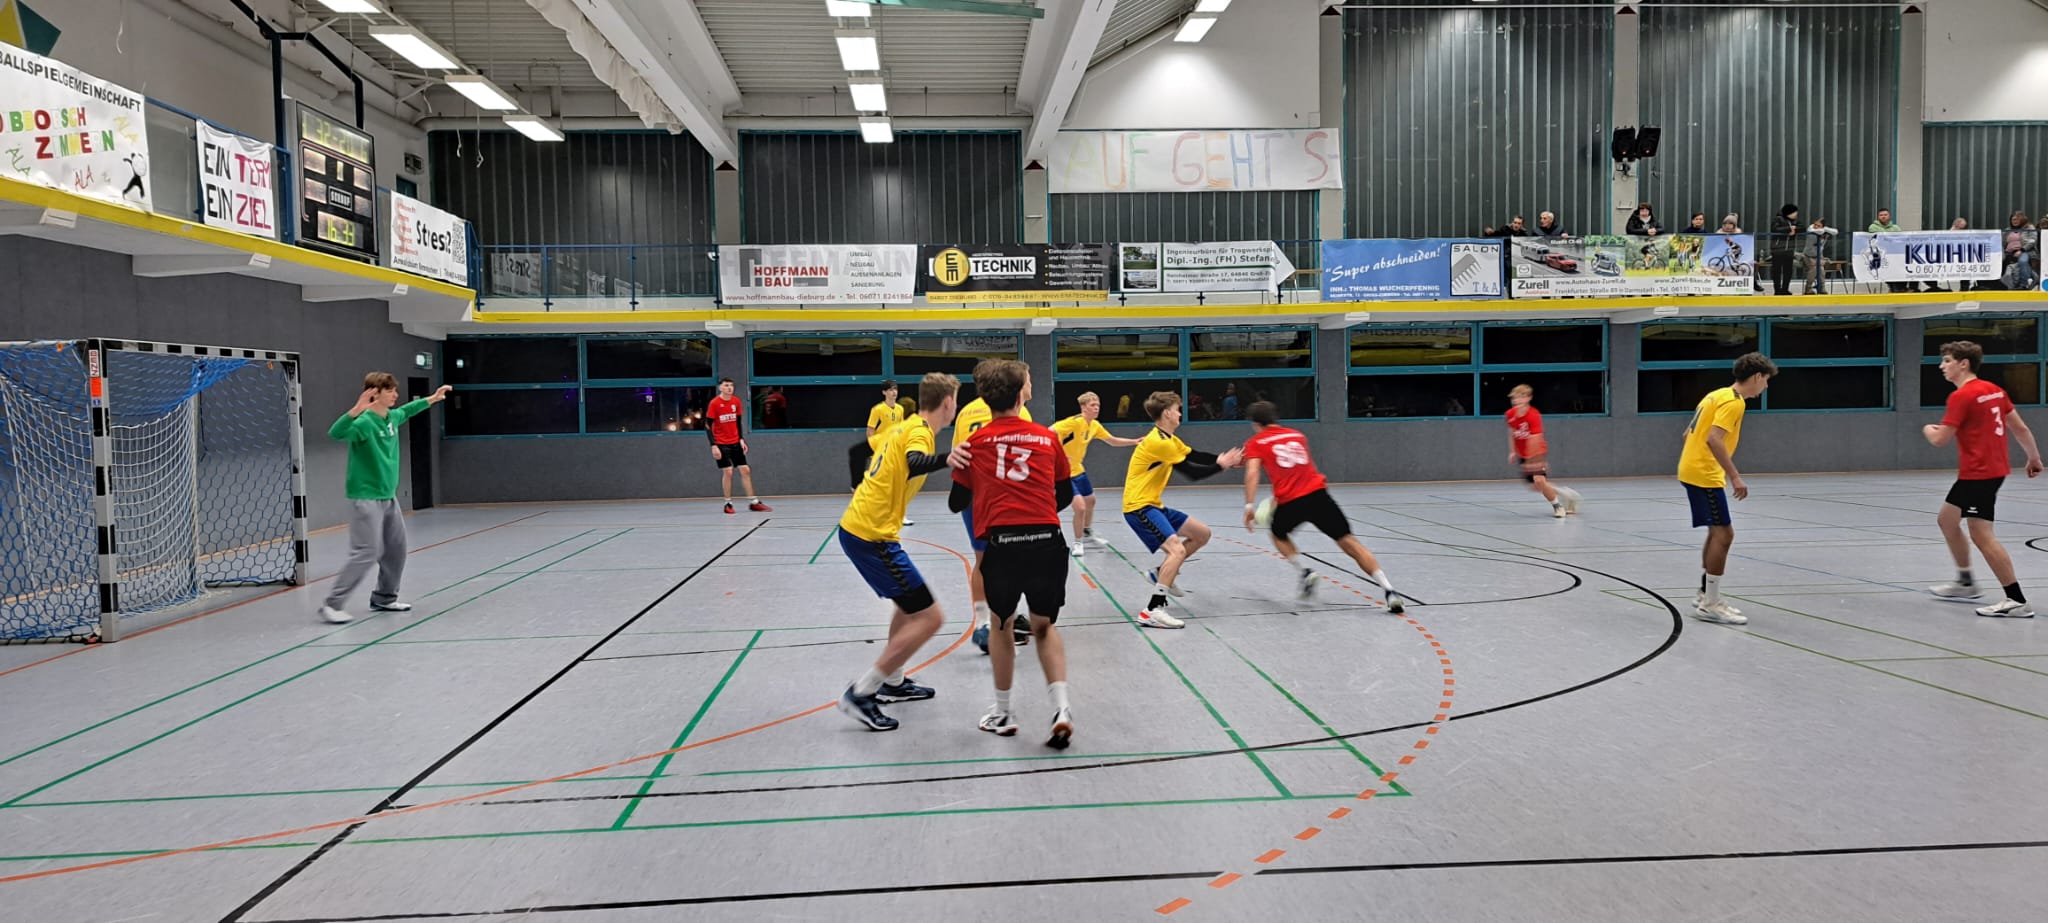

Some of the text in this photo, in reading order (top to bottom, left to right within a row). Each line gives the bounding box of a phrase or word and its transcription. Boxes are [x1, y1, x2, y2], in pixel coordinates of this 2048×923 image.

[204, 142, 231, 180] EIN
[1063, 132, 1151, 190] AUF
[206, 183, 272, 230] EIN ZIEL
[1167, 254, 1270, 265] Dipl.-Ing. (FH) Stefan
[1905, 243, 1985, 264] KUHN
[754, 266, 829, 276] HOFFMANN
[972, 260, 1033, 272] TECHNIK
[764, 277, 792, 287] BAU
[1472, 281, 1498, 292] T & A
[1518, 280, 1549, 290] Zurell
[1717, 278, 1749, 288] Zurell
[1991, 406, 2004, 436] 3
[996, 443, 1032, 481] 13
